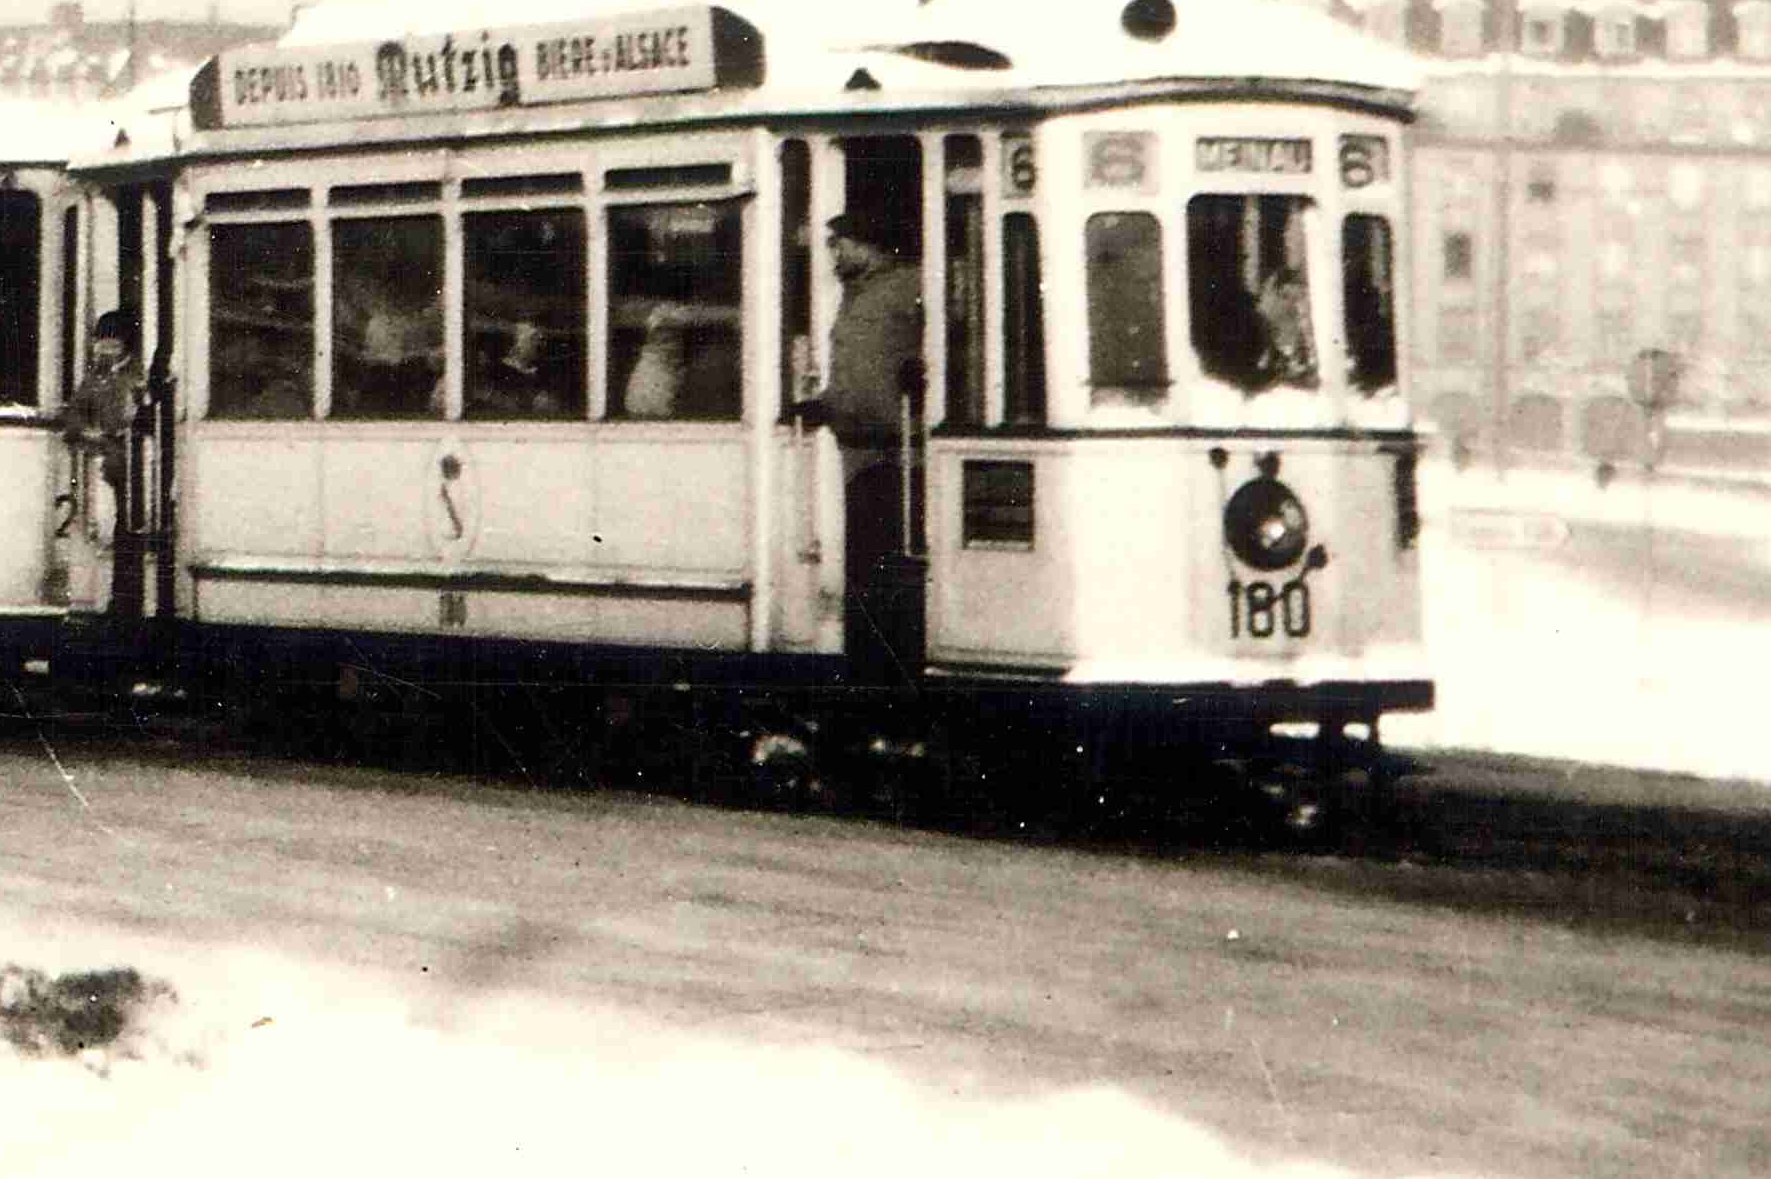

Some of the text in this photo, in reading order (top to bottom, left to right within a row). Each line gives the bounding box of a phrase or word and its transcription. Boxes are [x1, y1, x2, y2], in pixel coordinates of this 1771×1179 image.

[234, 66, 308, 105] DEPUIS
[376, 30, 520, 105] Mutzig
[1339, 144, 1374, 188] 6
[1227, 579, 1311, 638] 180
